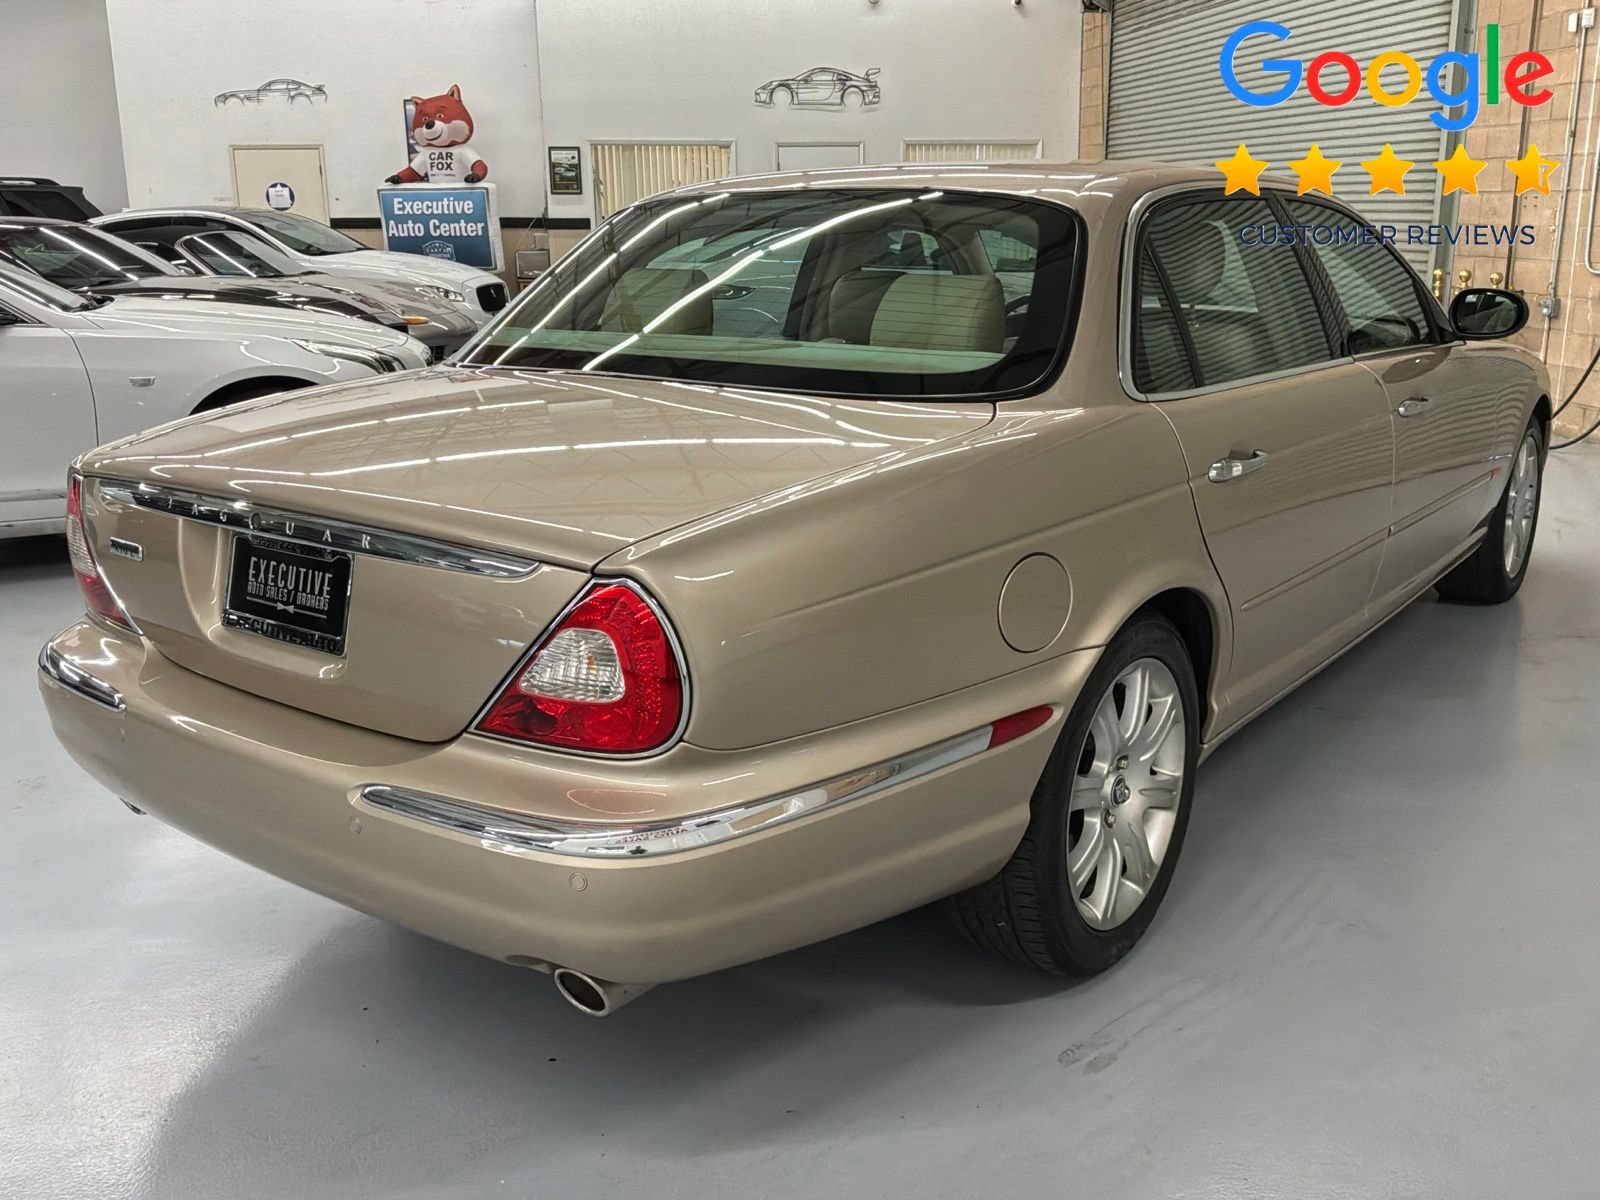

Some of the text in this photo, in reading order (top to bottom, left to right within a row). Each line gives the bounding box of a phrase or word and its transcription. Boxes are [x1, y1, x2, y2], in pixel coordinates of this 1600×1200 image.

[428, 151, 454, 161] CAR
[429, 161, 453, 171] FOX
[393, 197, 474, 215] Executive
[388, 219, 485, 237] Auto Center
[166, 496, 371, 549] JAGUAR
[248, 556, 333, 598] EXECUTIVE
[247, 581, 265, 597] AUTO
[265, 585, 288, 602] SALES
[296, 592, 329, 611] BROKERS
